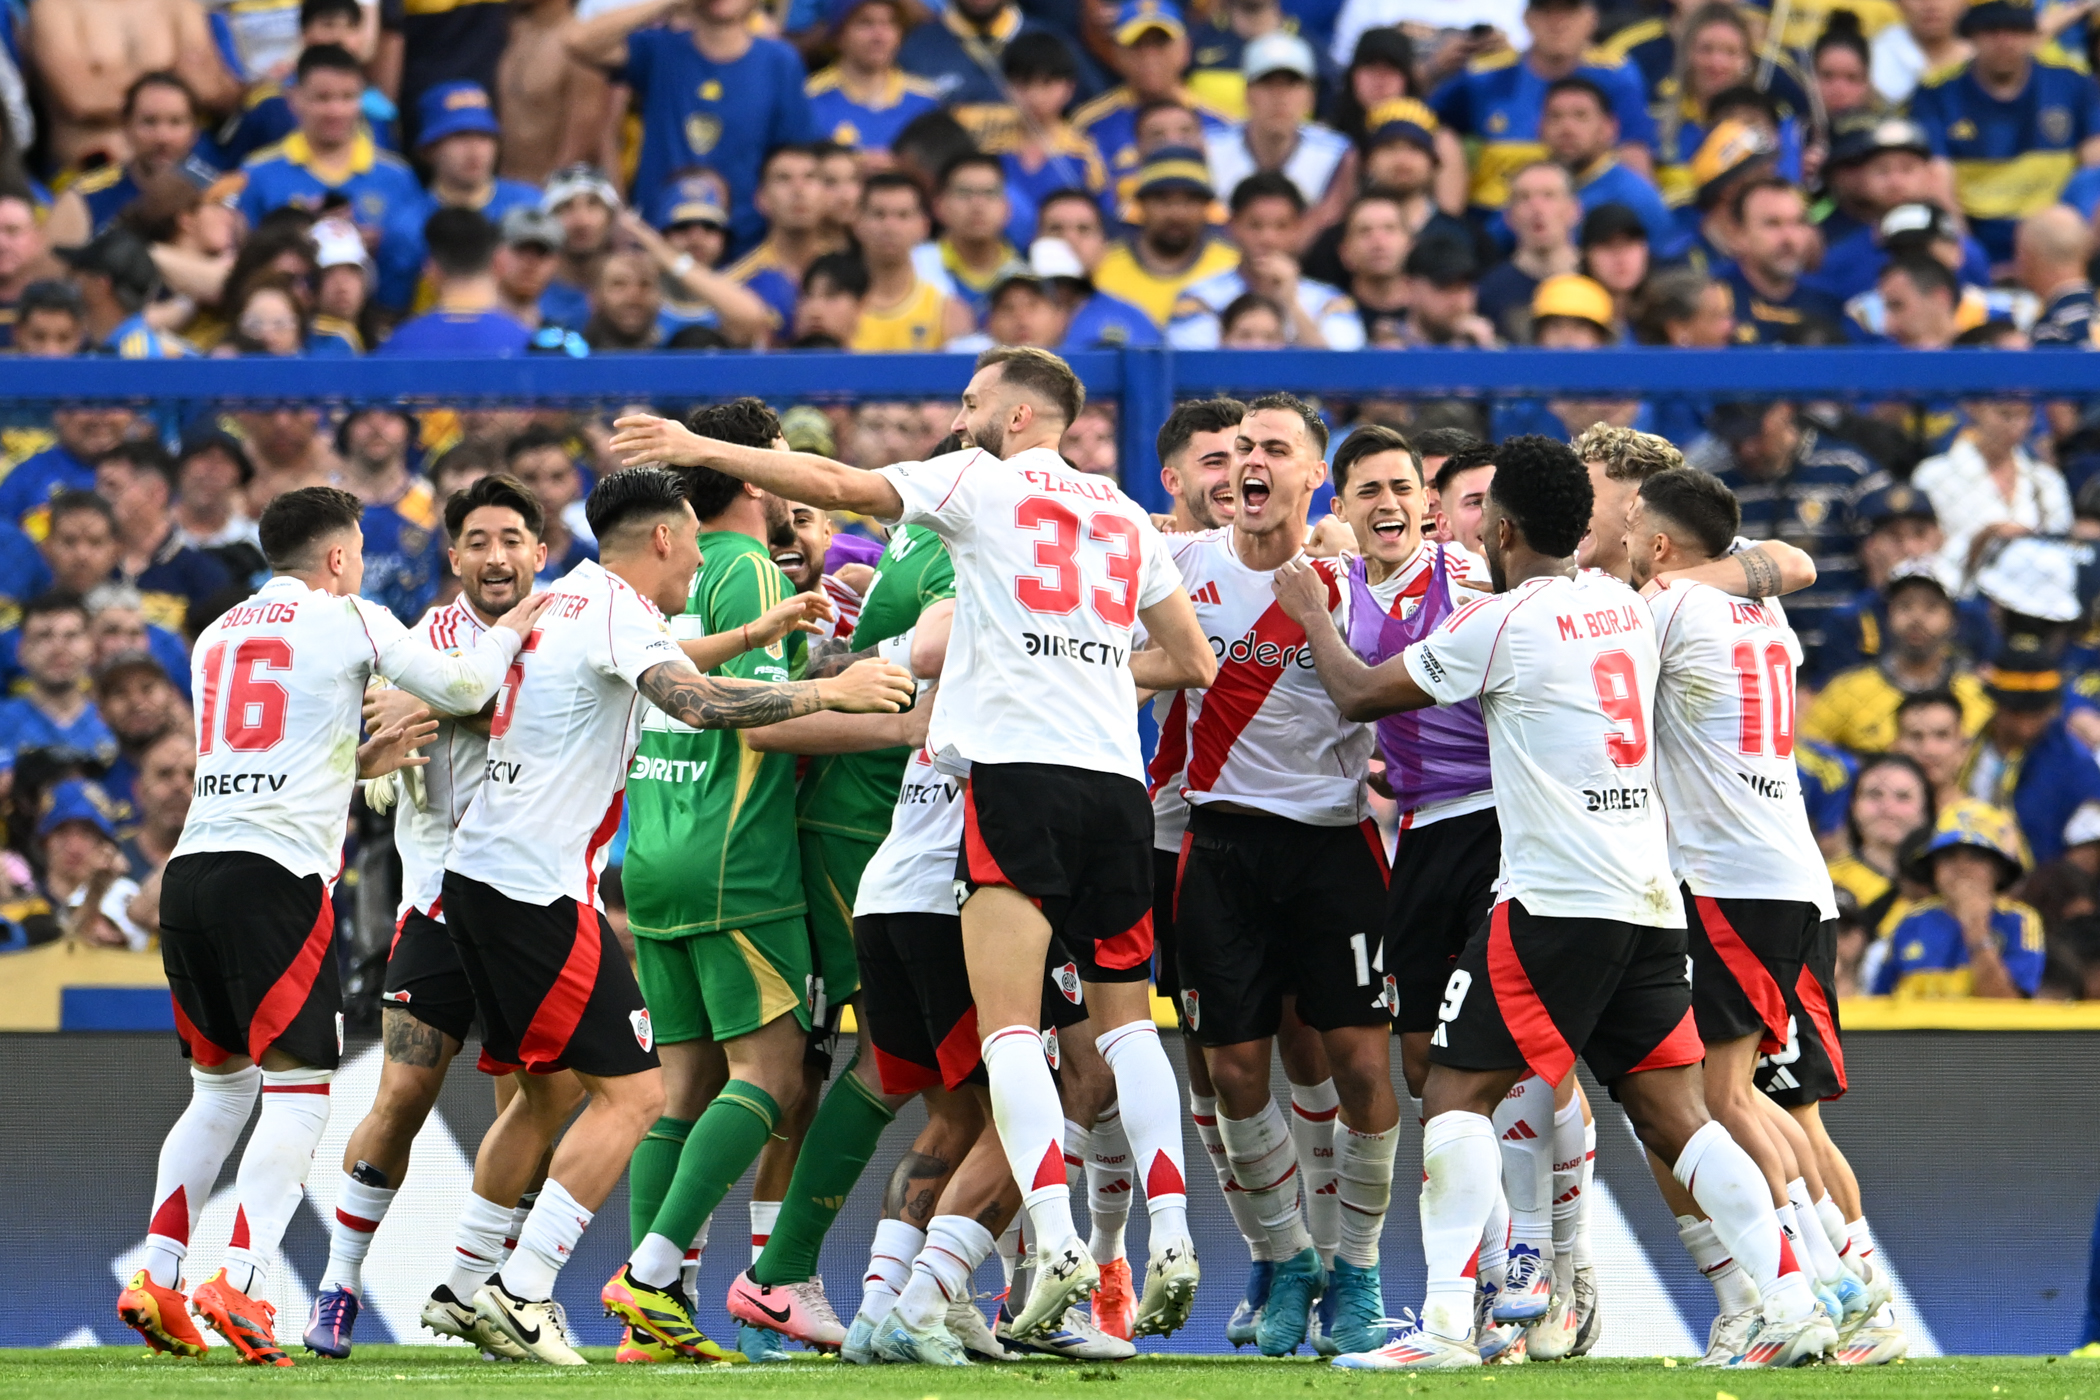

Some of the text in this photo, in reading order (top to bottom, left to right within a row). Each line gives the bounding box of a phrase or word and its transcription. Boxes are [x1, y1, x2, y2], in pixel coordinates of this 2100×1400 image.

[1018, 470, 1119, 504] EZZELLA
[1014, 494, 1143, 631] 33
[220, 601, 299, 630] BUSTOS
[1556, 604, 1643, 642] M. BORJA
[1022, 632, 1124, 668] DIRECTV
[198, 636, 295, 757] 16
[1590, 648, 1648, 768] 9
[1731, 639, 1795, 760] 10
[1438, 968, 1472, 1023] 9
[1095, 1153, 1126, 1165] CARP
[1552, 1156, 1582, 1172] CARP
